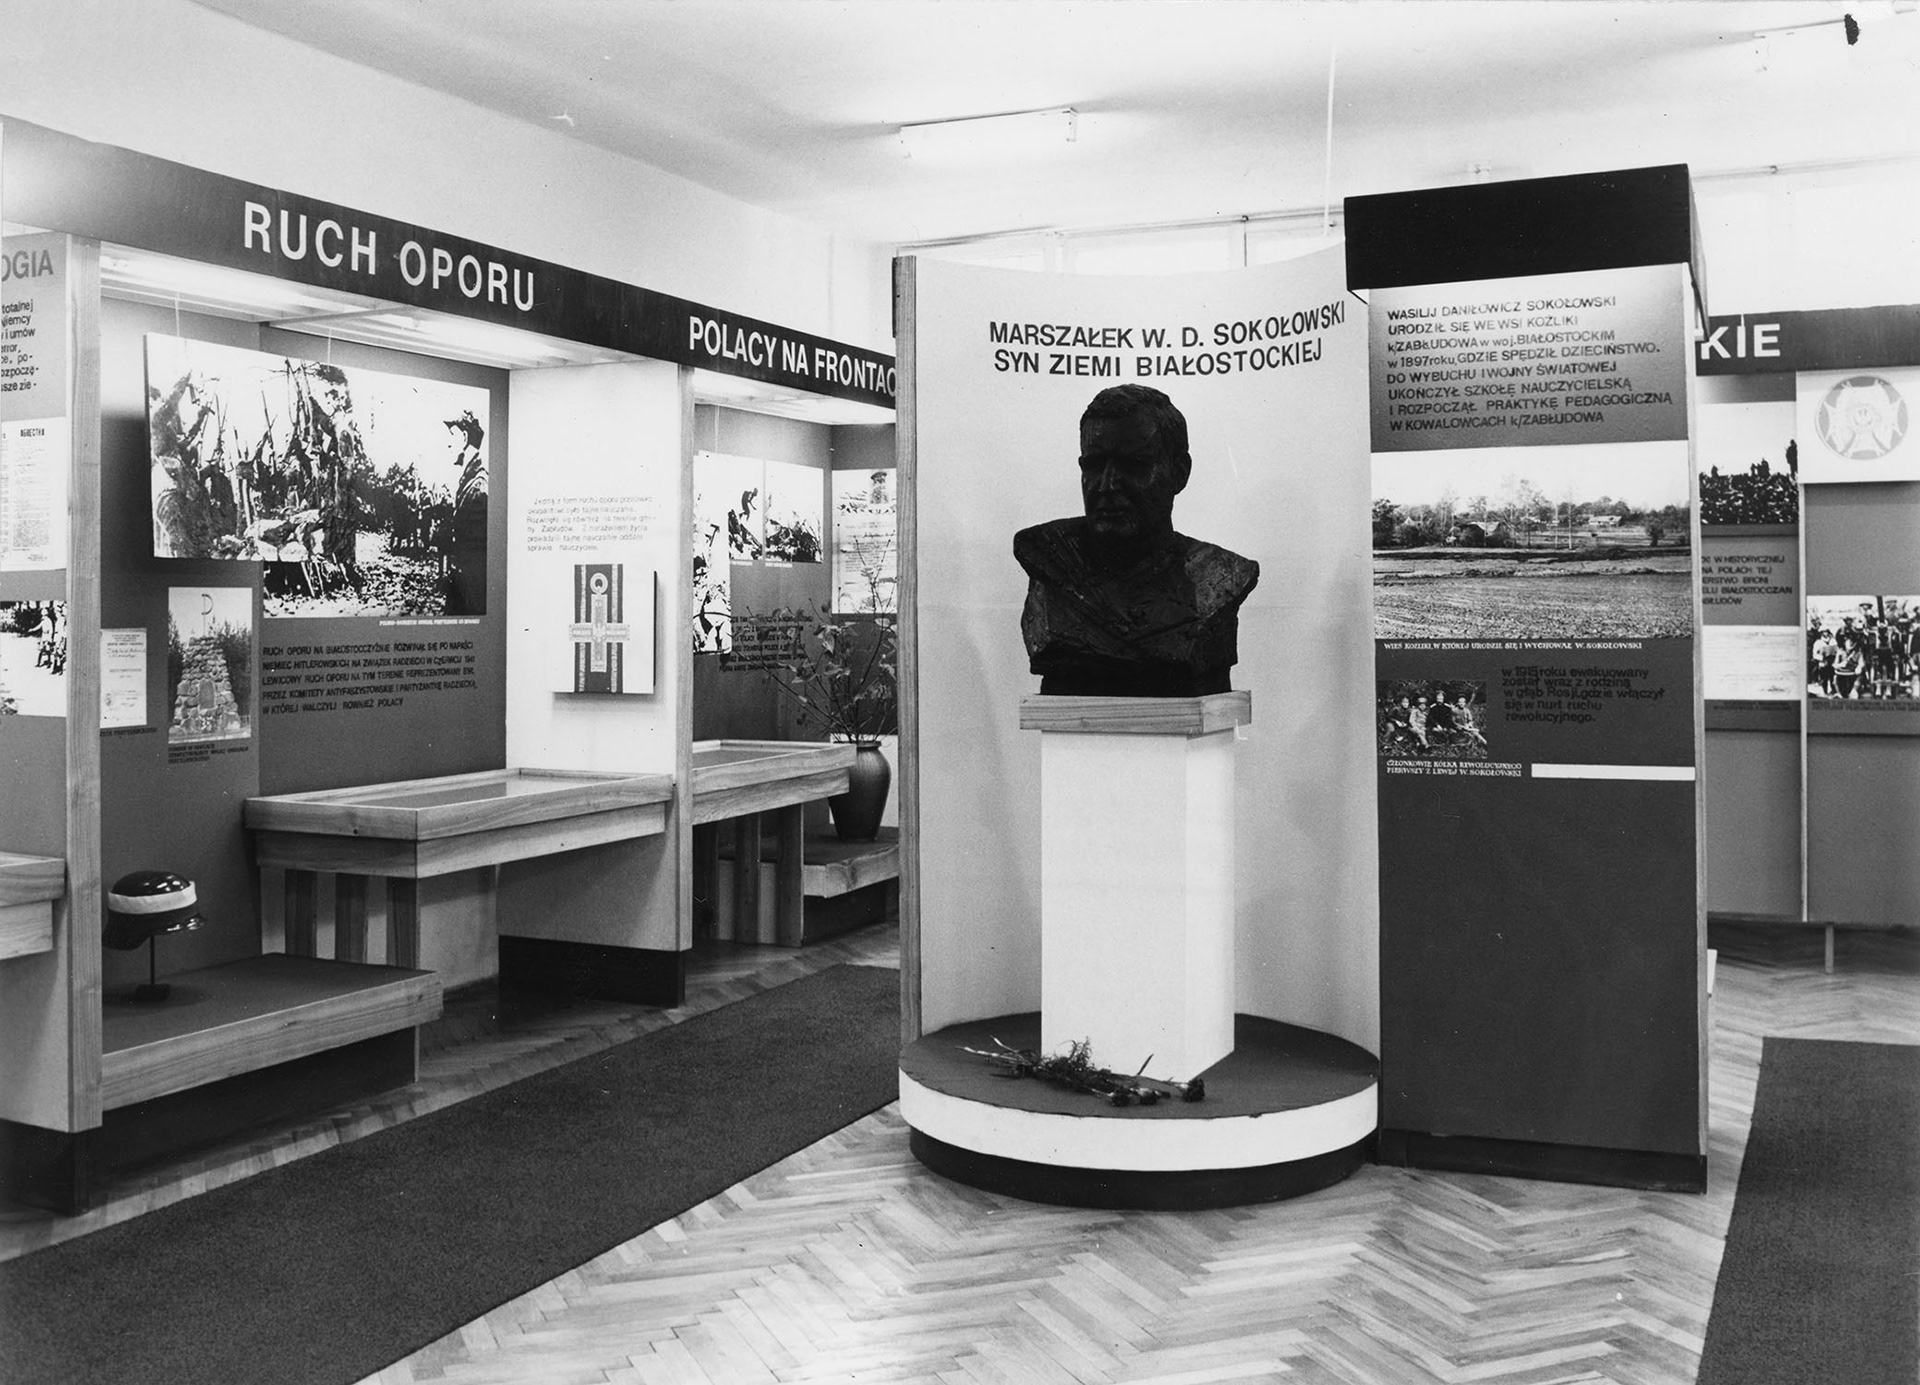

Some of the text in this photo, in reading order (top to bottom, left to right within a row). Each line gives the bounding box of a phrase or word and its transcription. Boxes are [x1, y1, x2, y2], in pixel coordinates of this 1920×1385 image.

[244, 201, 535, 312] RUCH OPORU
[1526, 296, 1616, 311] SOKOŁOWSKI
[989, 301, 1345, 349] MARSZAŁEK W. D. SOKOŁOWSKI
[1388, 322, 1446, 336] URODZIŁ
[1450, 320, 1470, 334] SIĘ
[1474, 320, 1495, 331] WE
[1498, 319, 1522, 330] WSI
[689, 315, 777, 368] POLACY
[782, 339, 809, 376] NA
[1701, 323, 1781, 360] KIE
[994, 337, 1323, 377] SYN ZIEMI BIAŁOSTOCKIEJ
[1502, 348, 1557, 362] SPĘDZIŁ
[1387, 372, 1406, 384] DO
[1410, 368, 1476, 383] WYBUCHU
[1486, 366, 1533, 379] WOJNY
[1536, 361, 1616, 376] ŚWIATOWEJ
[1388, 377, 1632, 400] UKOŃCZYŁ SZKOŁĘ NAUCZYCIELSKĄ
[1390, 405, 1394, 415] I
[1398, 402, 1478, 415] ROZPOCZĄŁ
[1486, 397, 1558, 411] PRAKTYKĘ
[1390, 420, 1403, 431] W
[1405, 416, 1506, 431] KOWALOWCACH
[263, 646, 284, 656] RUCH
[287, 645, 311, 655] OPORU
[313, 645, 323, 655] NA
[304, 674, 325, 684] RUCH
[326, 673, 349, 683] OPORU
[1544, 678, 1573, 687] wraz
